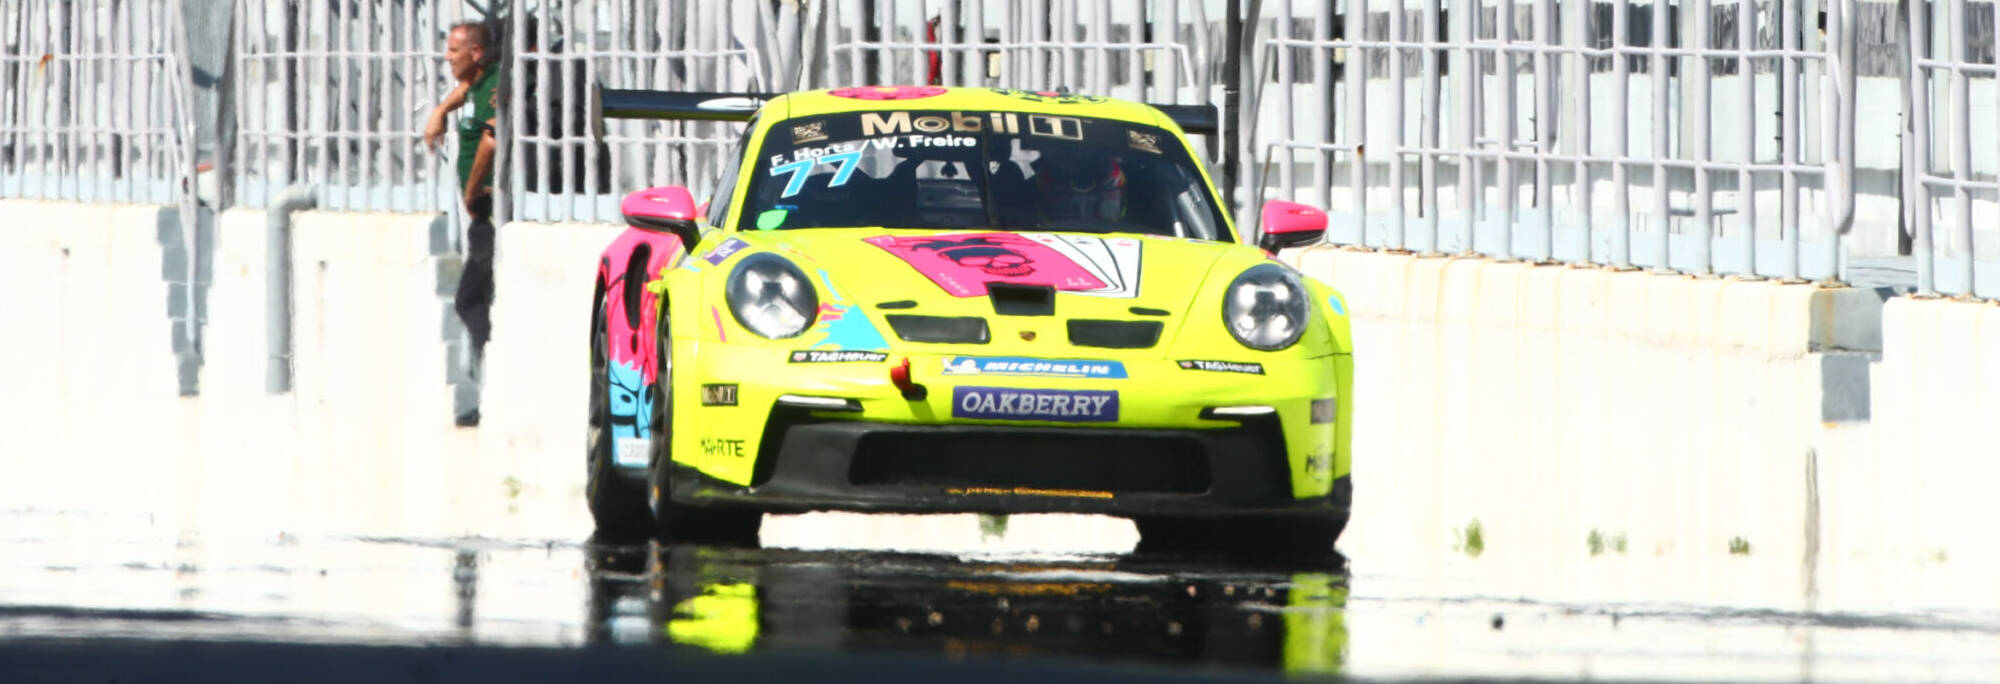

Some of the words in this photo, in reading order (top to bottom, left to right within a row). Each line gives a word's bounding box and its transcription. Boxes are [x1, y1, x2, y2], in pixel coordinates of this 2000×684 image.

[861, 111, 1019, 136] Mobil
[909, 135, 977, 148] Freire
[770, 150, 863, 198] 77
[984, 362, 1110, 374] MICHELIN
[962, 391, 1110, 416] OAKBERRY
